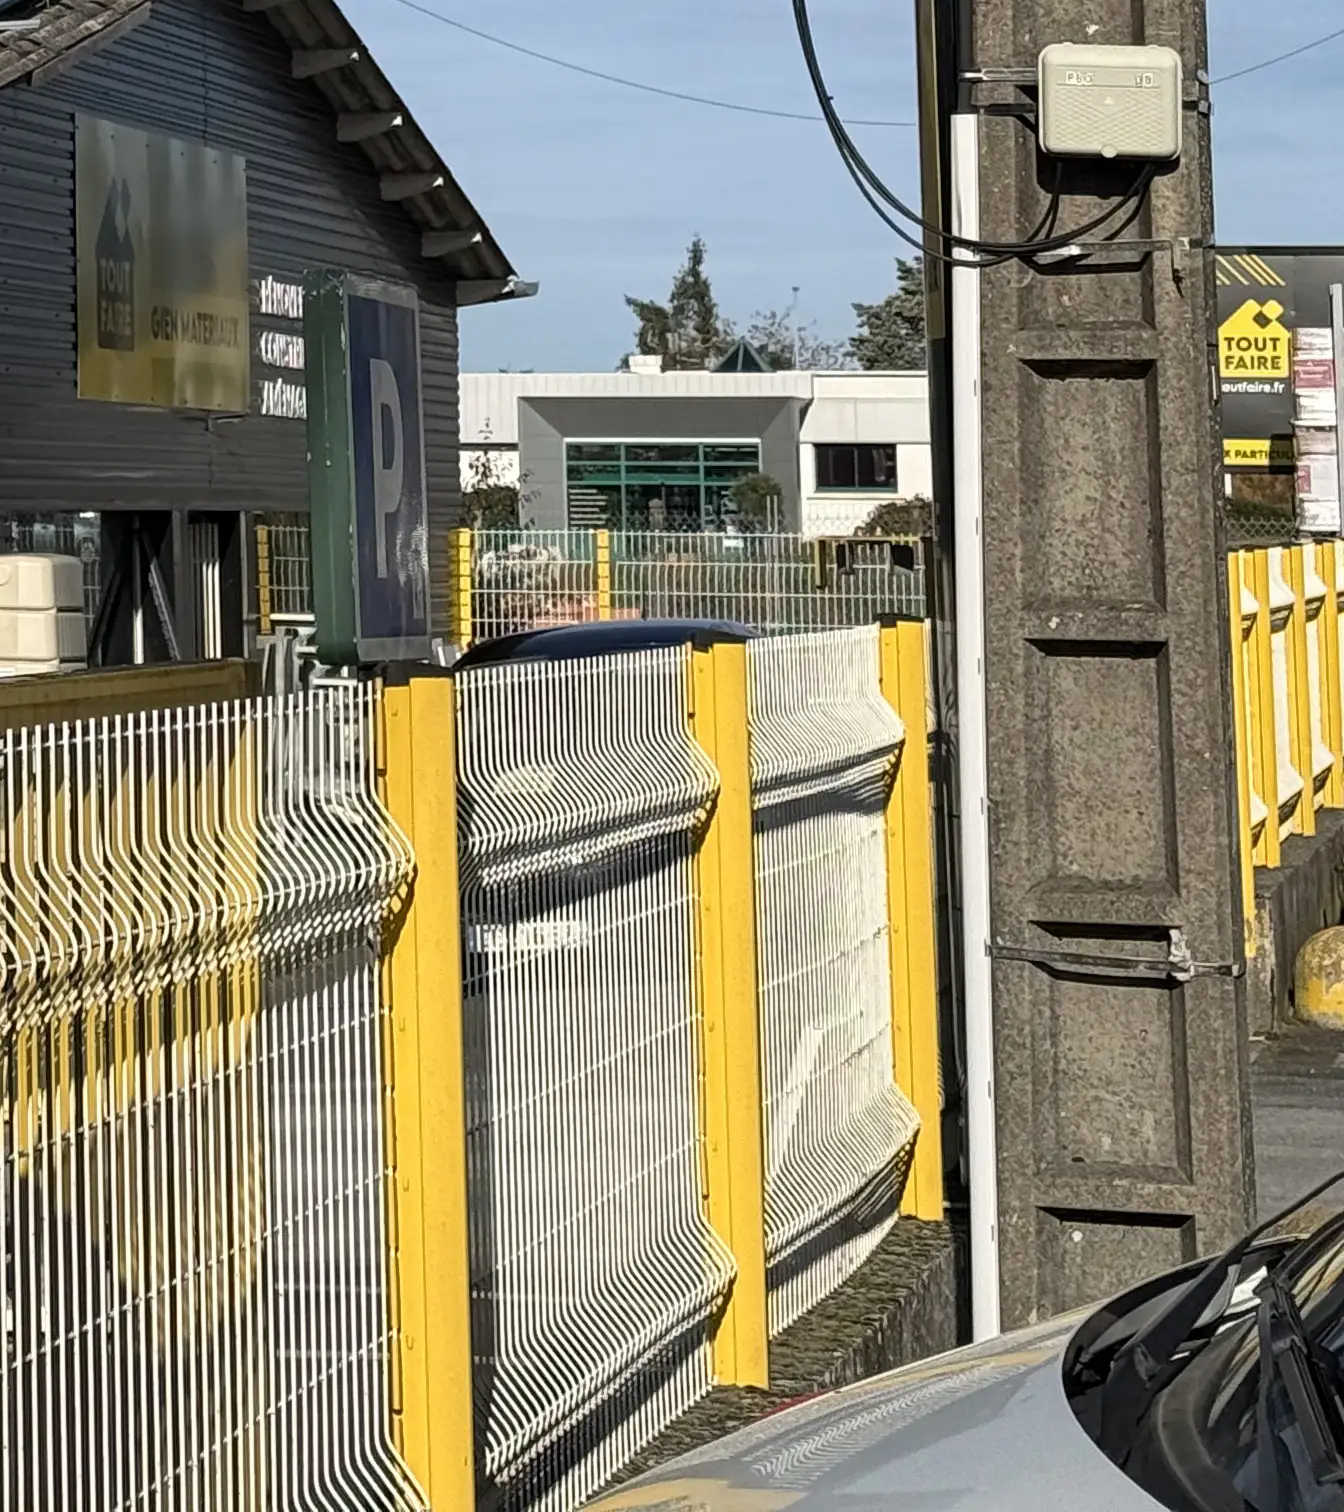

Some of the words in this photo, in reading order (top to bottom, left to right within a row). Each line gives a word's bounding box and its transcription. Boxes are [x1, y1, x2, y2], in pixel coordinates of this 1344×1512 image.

[100, 261, 130, 294] TOUT
[100, 299, 131, 336] FAIRE
[150, 305, 178, 341] GIEN
[1224, 336, 1281, 353] TOUT
[1224, 355, 1282, 371] FAIRE
[1221, 380, 1285, 394] outfaire.fr
[1235, 449, 1293, 460] PARTICUL
[370, 358, 404, 579] P
